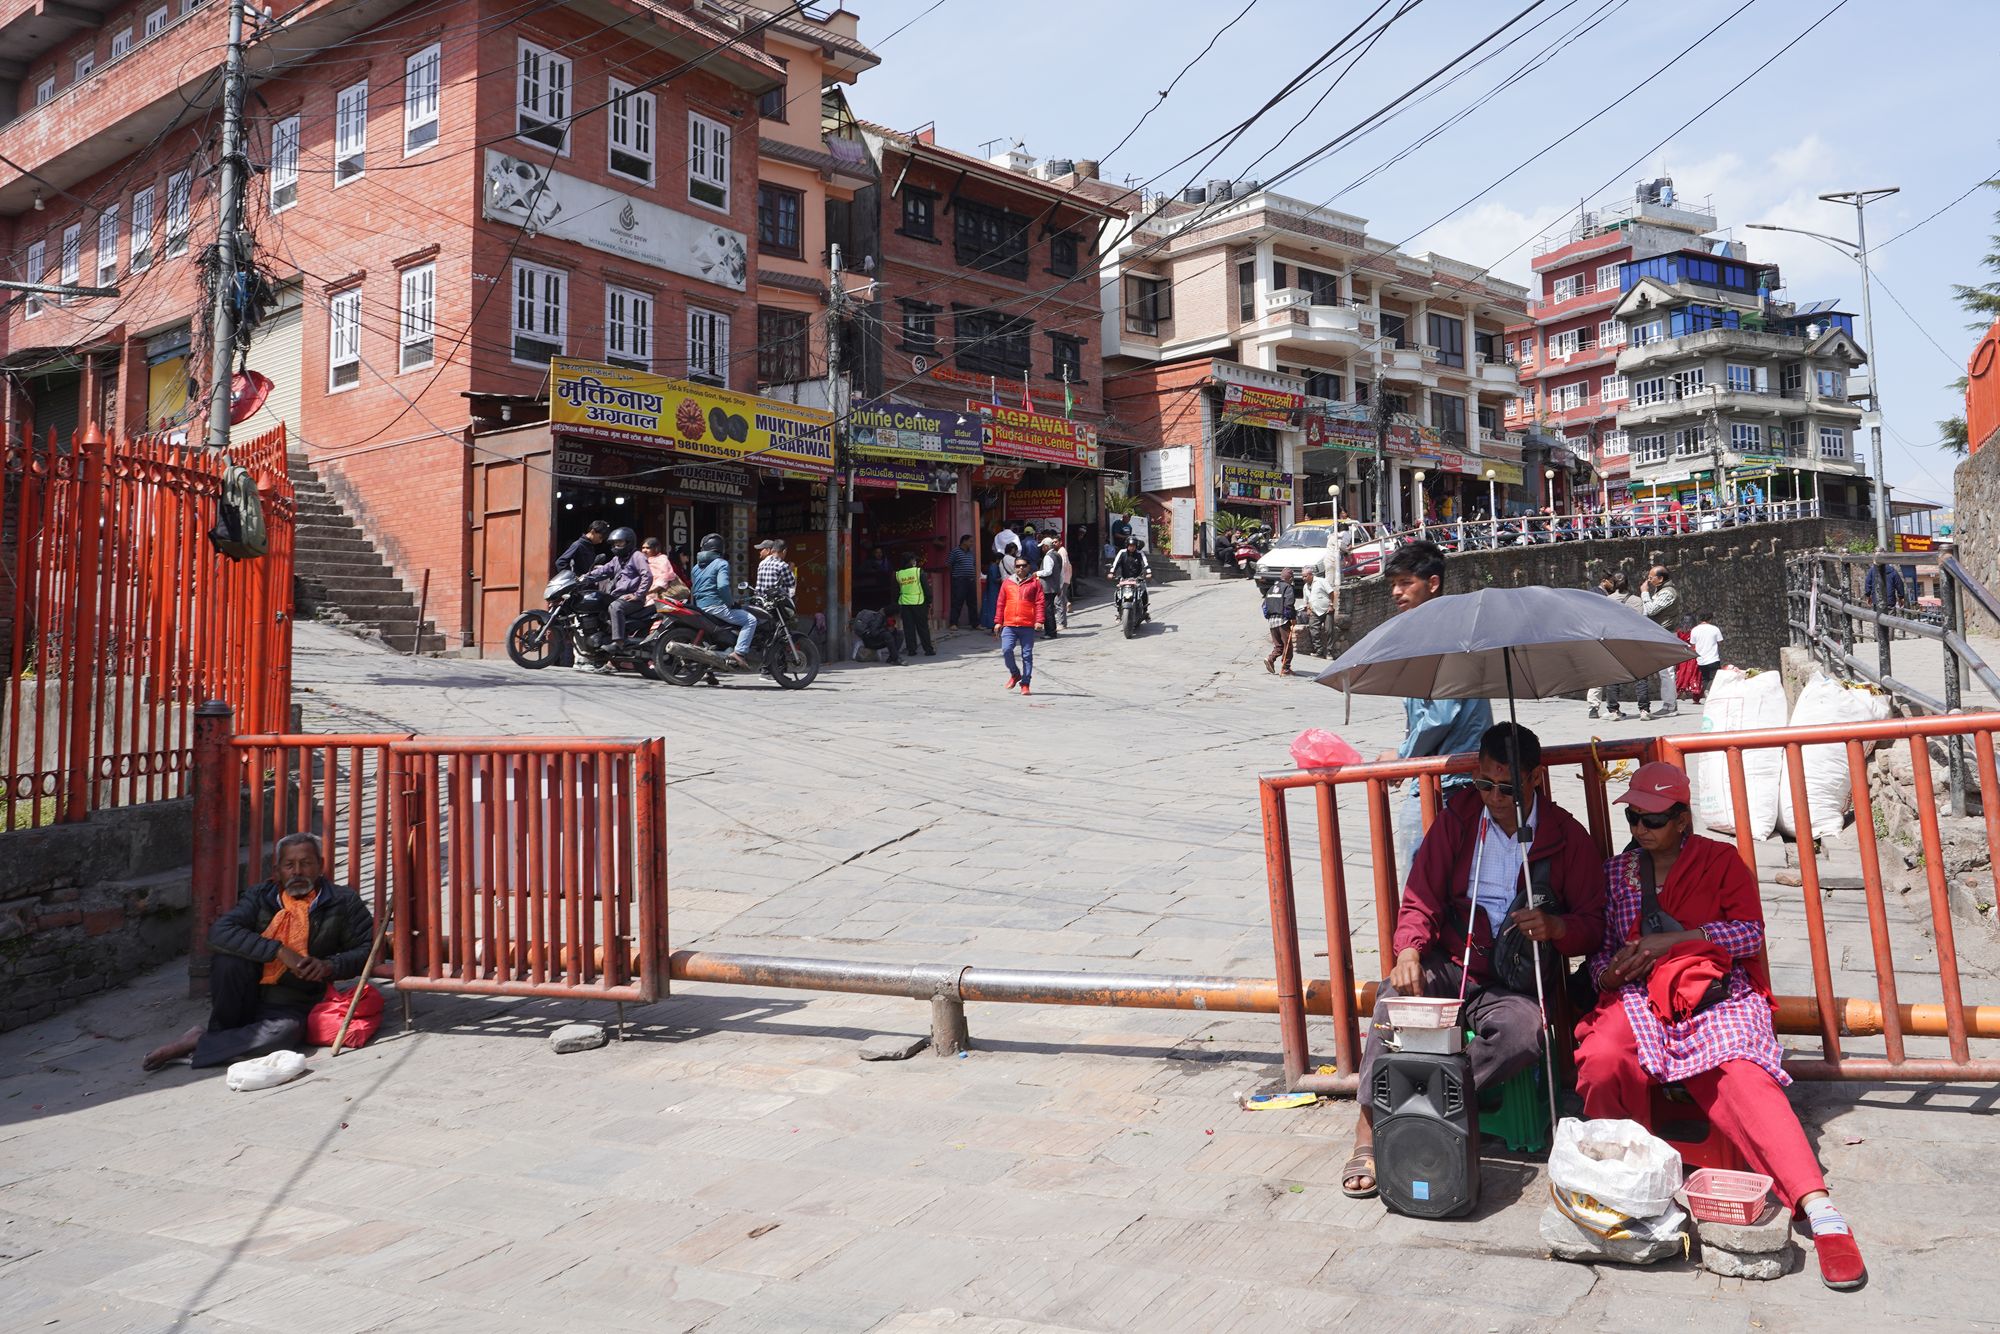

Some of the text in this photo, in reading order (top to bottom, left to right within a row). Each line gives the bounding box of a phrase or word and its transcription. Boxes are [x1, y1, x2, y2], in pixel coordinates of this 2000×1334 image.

[619, 237, 639, 247] CAFE
[557, 376, 664, 414] मुक्तिनाथ
[586, 405, 658, 429] अग्रवाल
[755, 414, 832, 443] MUKTINATH
[849, 408, 892, 428] Divine
[894, 412, 941, 433] Center
[995, 409, 1073, 436] AGRAWAL
[677, 439, 742, 459] 9801035497
[769, 433, 832, 459] AGARWAL
[995, 425, 1023, 441] Rudra
[1045, 434, 1074, 451] Center
[604, 480, 665, 494] 9801035497
[672, 466, 750, 486] MUKTINATH
[680, 478, 743, 496] AGARWAL
[1008, 488, 1062, 499] AGRAWAL
